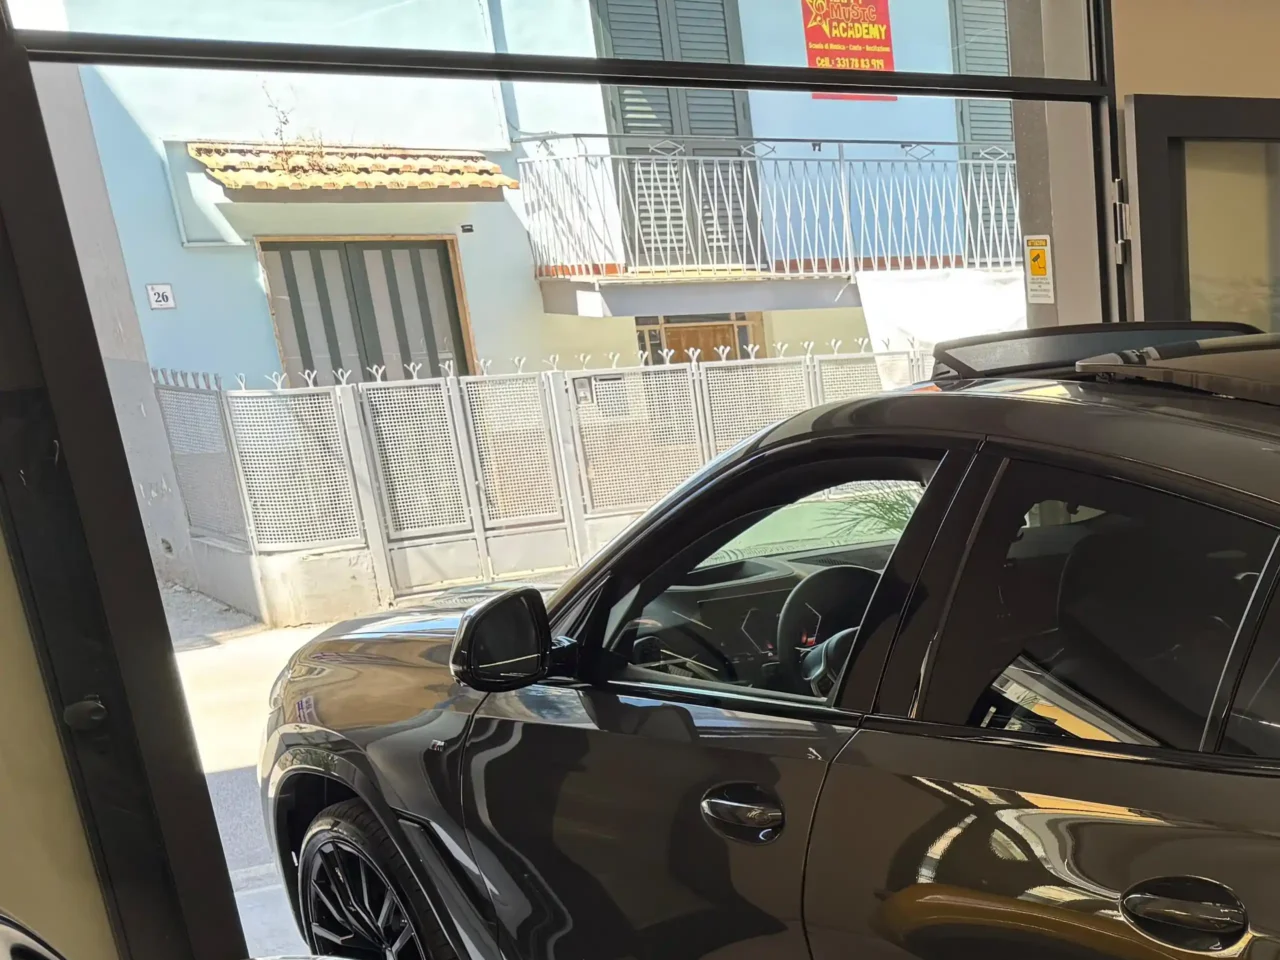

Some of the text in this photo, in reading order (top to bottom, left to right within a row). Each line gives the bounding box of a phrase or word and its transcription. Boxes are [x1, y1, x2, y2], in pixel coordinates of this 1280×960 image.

[830, 3, 877, 23] MUSIC
[832, 22, 887, 40] ACADEMY
[153, 291, 169, 303] 26
